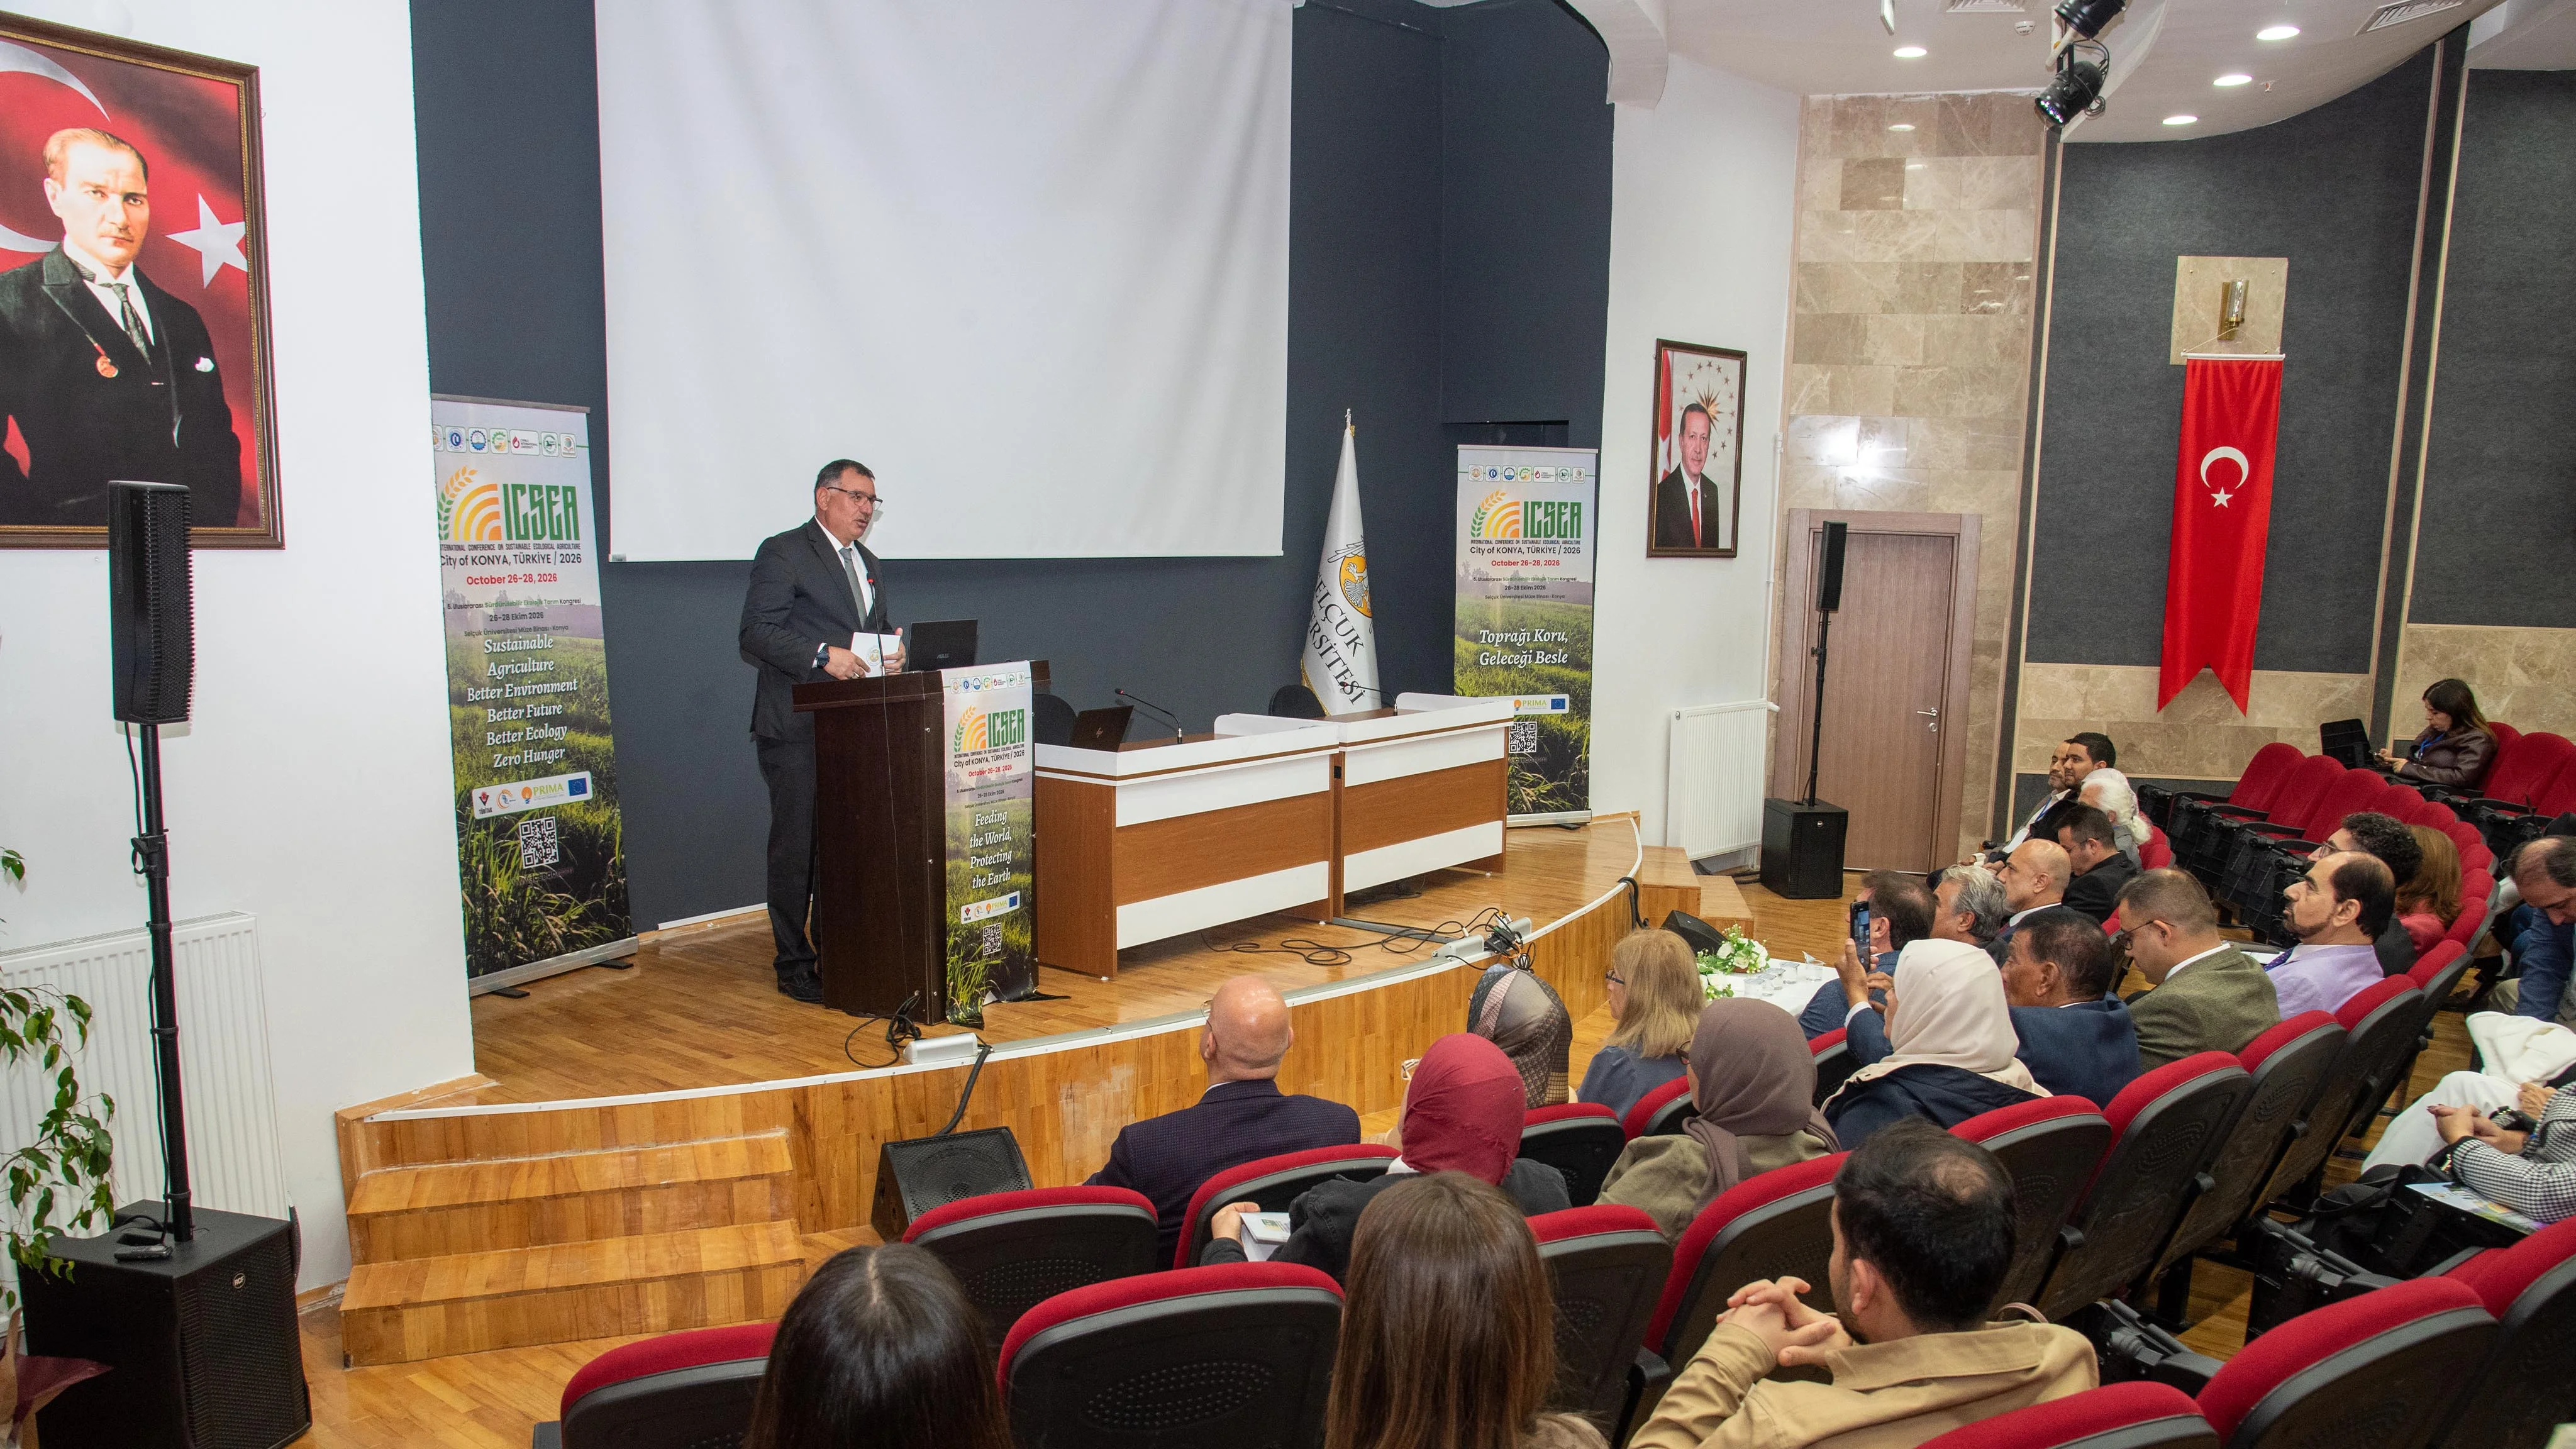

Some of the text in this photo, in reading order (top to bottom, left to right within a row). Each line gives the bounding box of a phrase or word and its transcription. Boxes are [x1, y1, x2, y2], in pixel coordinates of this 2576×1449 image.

[503, 484, 580, 540] ICSEA
[1523, 501, 1582, 538] ICSEA
[441, 555, 457, 569] City
[459, 555, 469, 566] of
[471, 555, 511, 566] KONYA,
[513, 552, 552, 564] TÜRKİYE
[559, 553, 582, 564] 2026
[1470, 547, 1485, 556] City
[1496, 547, 1524, 555] KONYA,
[1527, 545, 1557, 553] TÜRKİYE
[1558, 545, 1562, 555] /
[467, 574, 557, 585] October 26-28, 2026
[484, 627, 517, 635] Üniversitesi
[1479, 629, 1568, 647] Toprağı Koru,
[484, 634, 553, 654] Sustainable
[1309, 610, 1365, 705] ERSİTESİ
[1479, 649, 1568, 669] Geleceği Besle
[487, 658, 555, 680] Agriculture
[467, 679, 578, 702] Better Environment
[487, 704, 563, 723] Better Future
[486, 723, 567, 747] Better Ecology
[988, 709, 1024, 748] ICSEA
[493, 747, 565, 768] Zero Hunger
[954, 760, 964, 769] City
[972, 757, 990, 765] KONYA,
[991, 752, 1010, 762] TÜRKİYE
[1013, 750, 1024, 758] 2026
[969, 769, 987, 777] October
[534, 783, 564, 796] PRIMA
[975, 809, 1008, 826] Feeding
[970, 827, 1012, 848] the World,
[970, 849, 1013, 869] Protecting
[972, 868, 1011, 889] the Earth
[992, 900, 1008, 909] PRIMA
